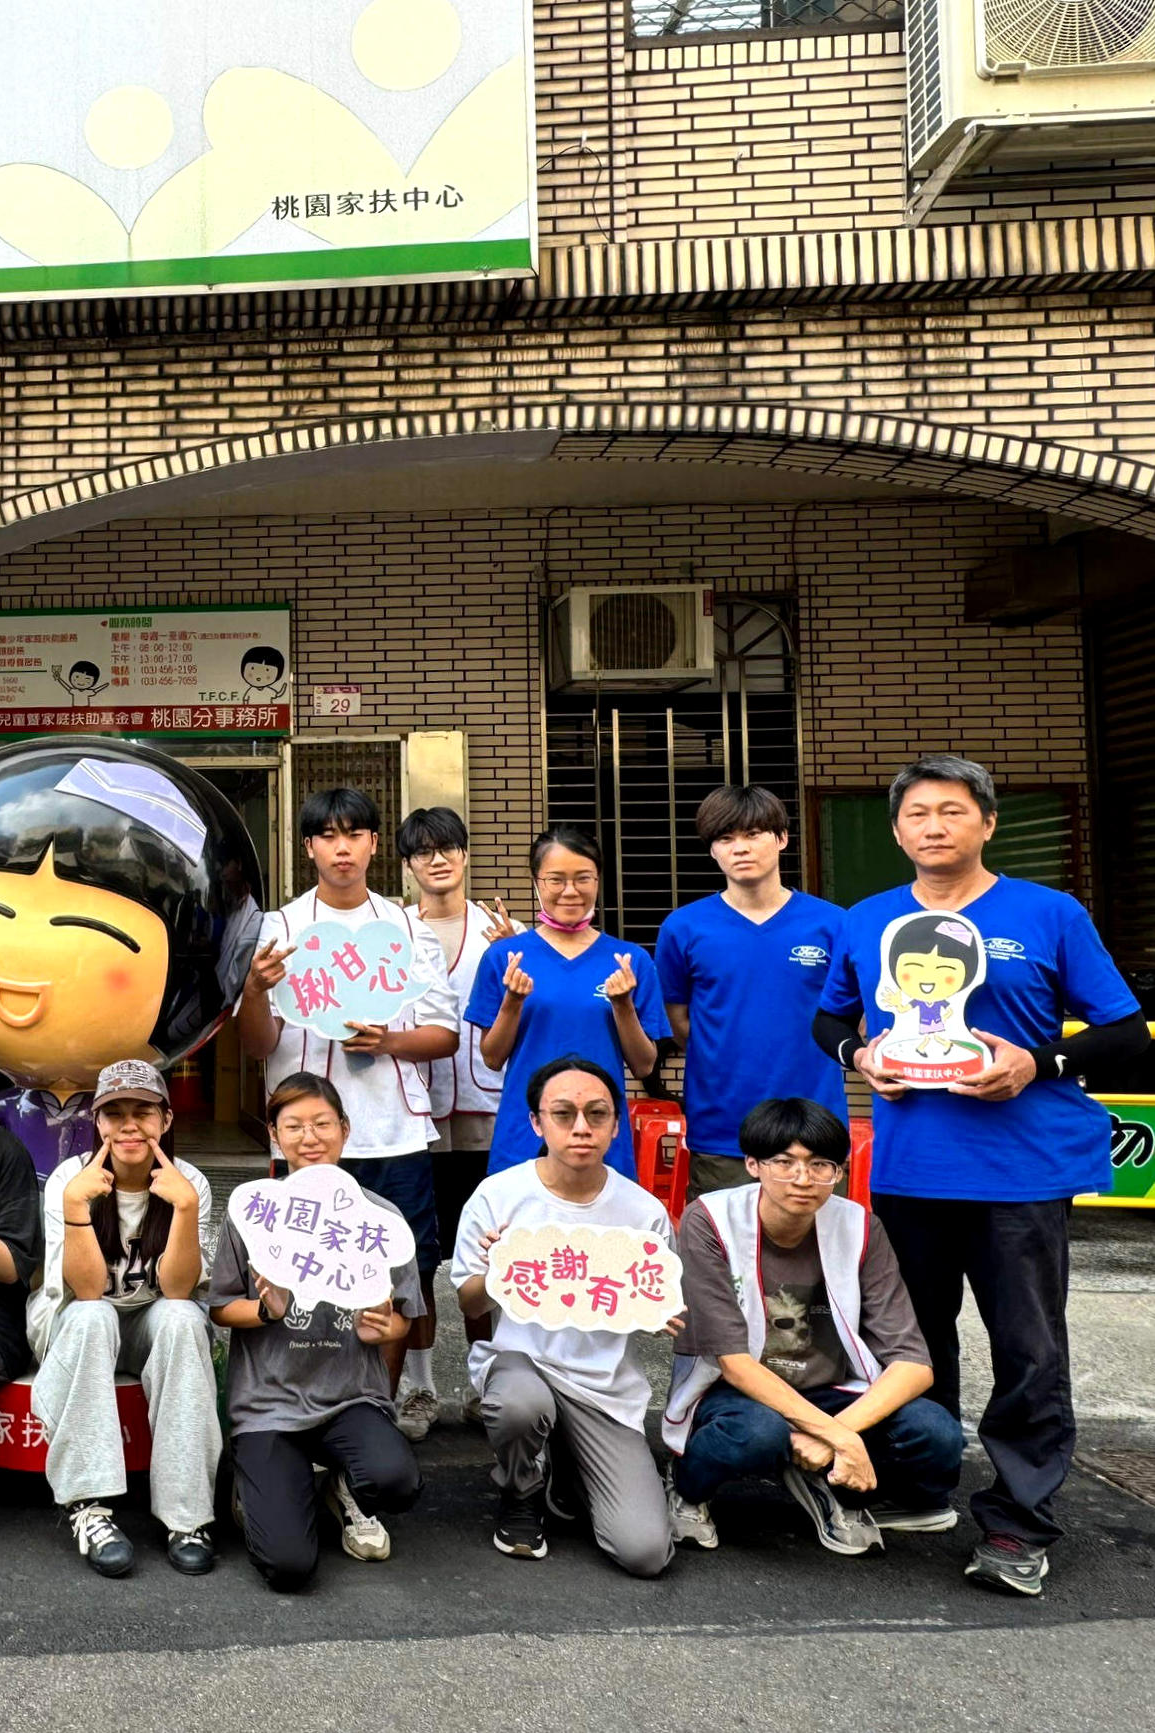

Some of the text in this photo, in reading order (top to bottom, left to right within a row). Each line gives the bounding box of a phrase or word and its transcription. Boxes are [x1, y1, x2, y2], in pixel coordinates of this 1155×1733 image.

[271, 184, 464, 220] 桃園家扶中心
[150, 705, 279, 729] 桃園分事務所
[330, 698, 350, 713] 29
[287, 942, 408, 1018] 揪甘心
[243, 1191, 390, 1259] 桃園家扶
[291, 1251, 356, 1291] 中心
[502, 1245, 666, 1317] 感謝有您
